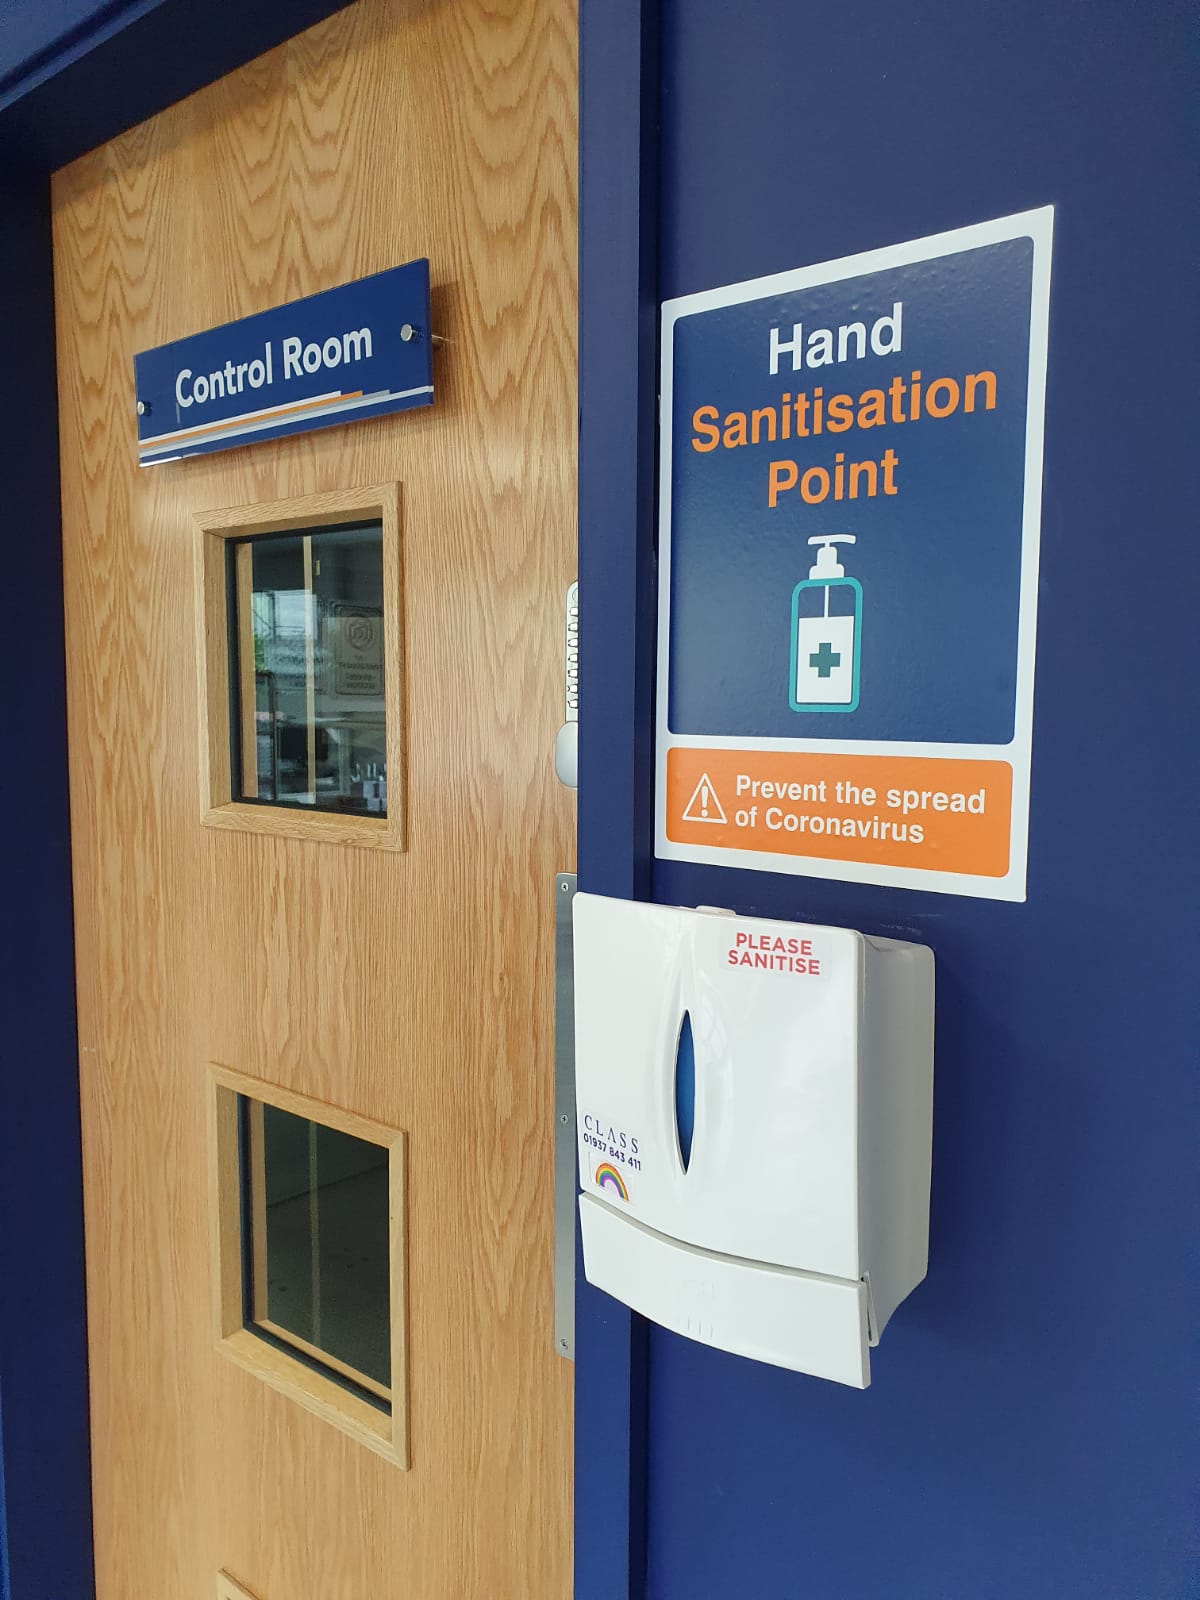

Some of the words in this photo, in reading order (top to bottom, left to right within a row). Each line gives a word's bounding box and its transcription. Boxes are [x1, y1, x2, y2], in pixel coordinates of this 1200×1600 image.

[769, 302, 903, 375] Hand
[175, 341, 273, 408] Control
[282, 327, 373, 379] Room
[691, 369, 998, 453] Sanitisation
[767, 448, 899, 508] Point
[736, 774, 826, 803] Prevent
[835, 781, 877, 806] the
[886, 789, 986, 815] spread
[735, 806, 758, 827] of
[765, 808, 924, 844] Coronavirus
[728, 949, 820, 975] SANITISE
[736, 933, 812, 956] PLEASE
[583, 1133, 607, 1152] 01937
[610, 1147, 625, 1162] 843
[628, 1157, 641, 1171] 411
[584, 1115, 638, 1154] CLASS
